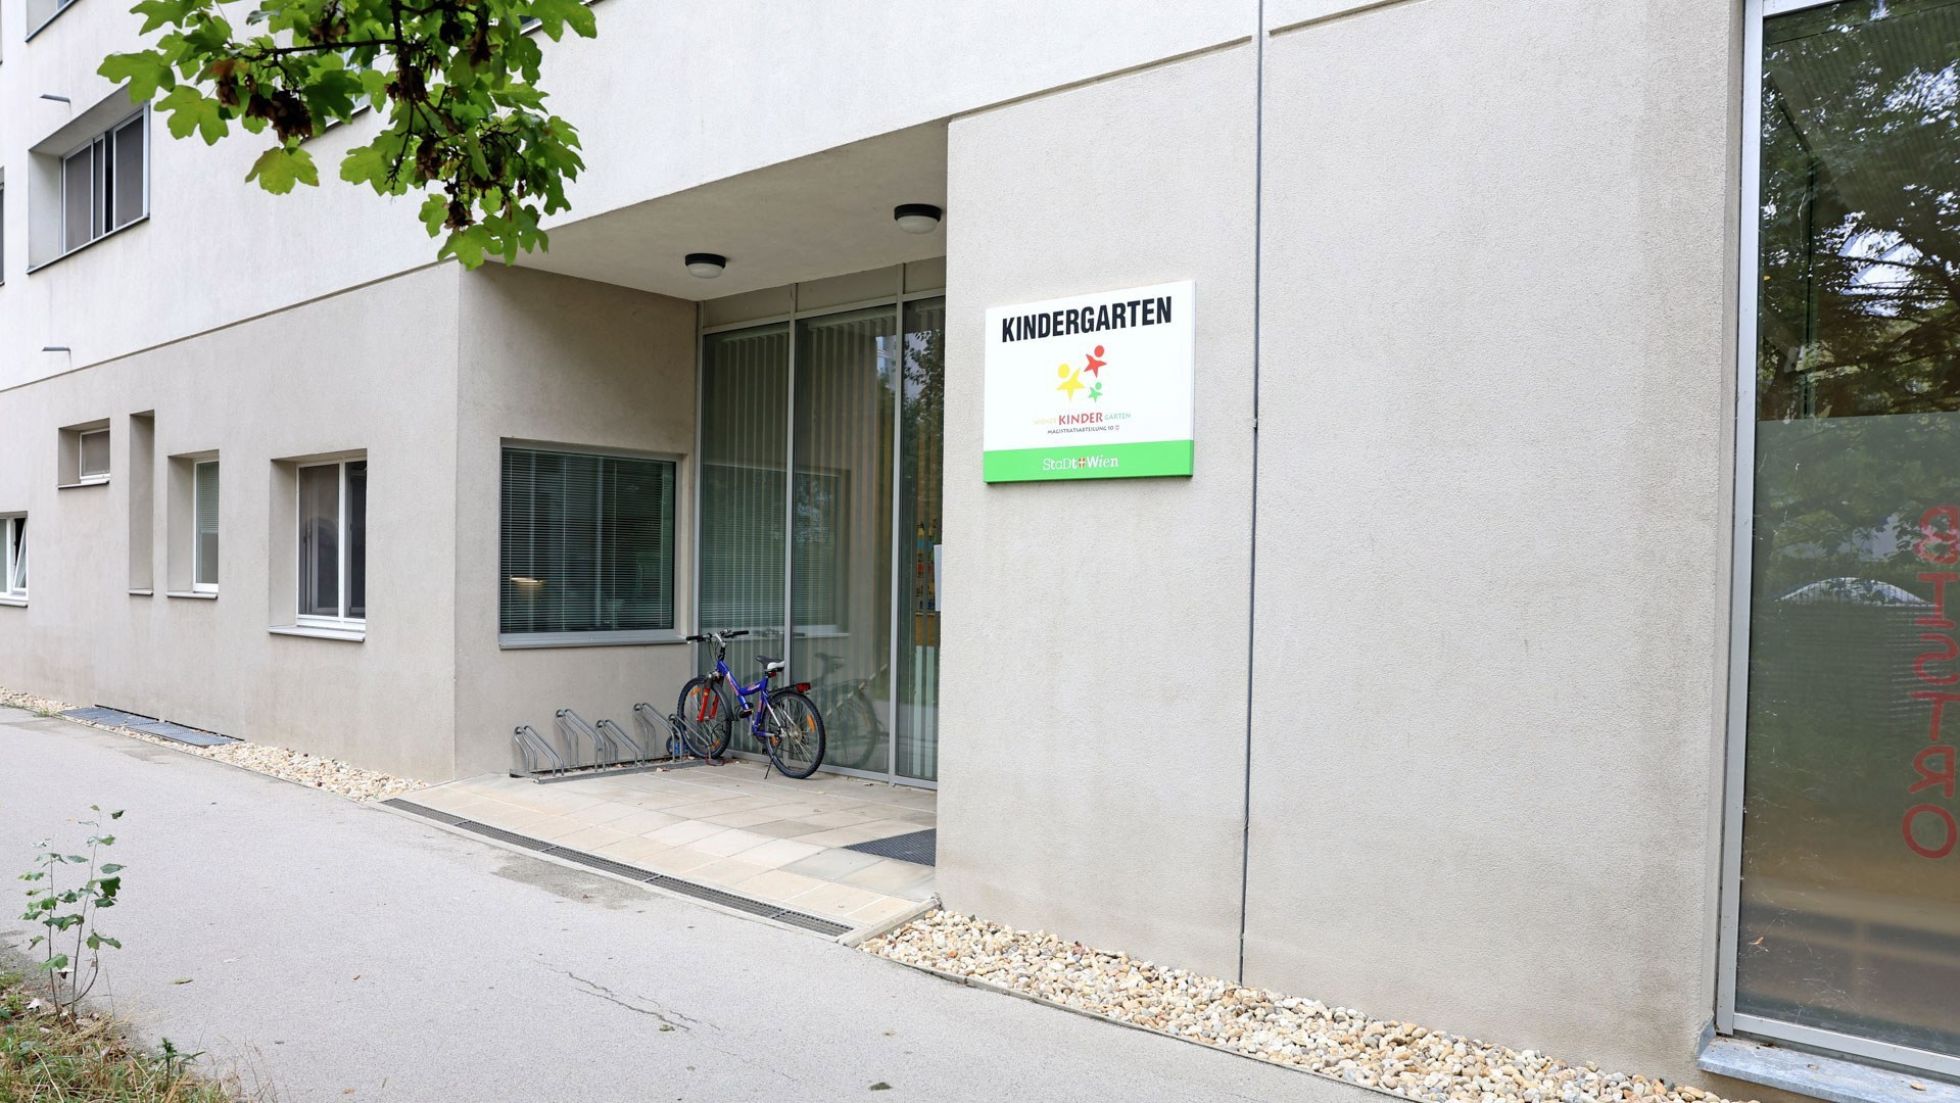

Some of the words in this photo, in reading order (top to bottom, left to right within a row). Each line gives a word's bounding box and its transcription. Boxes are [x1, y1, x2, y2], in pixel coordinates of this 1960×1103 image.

[1001, 296, 1173, 343] KINDERGARTEN
[1058, 412, 1103, 425] KINDER
[1104, 412, 1132, 421] GARTEN
[1087, 454, 1119, 468] Wien
